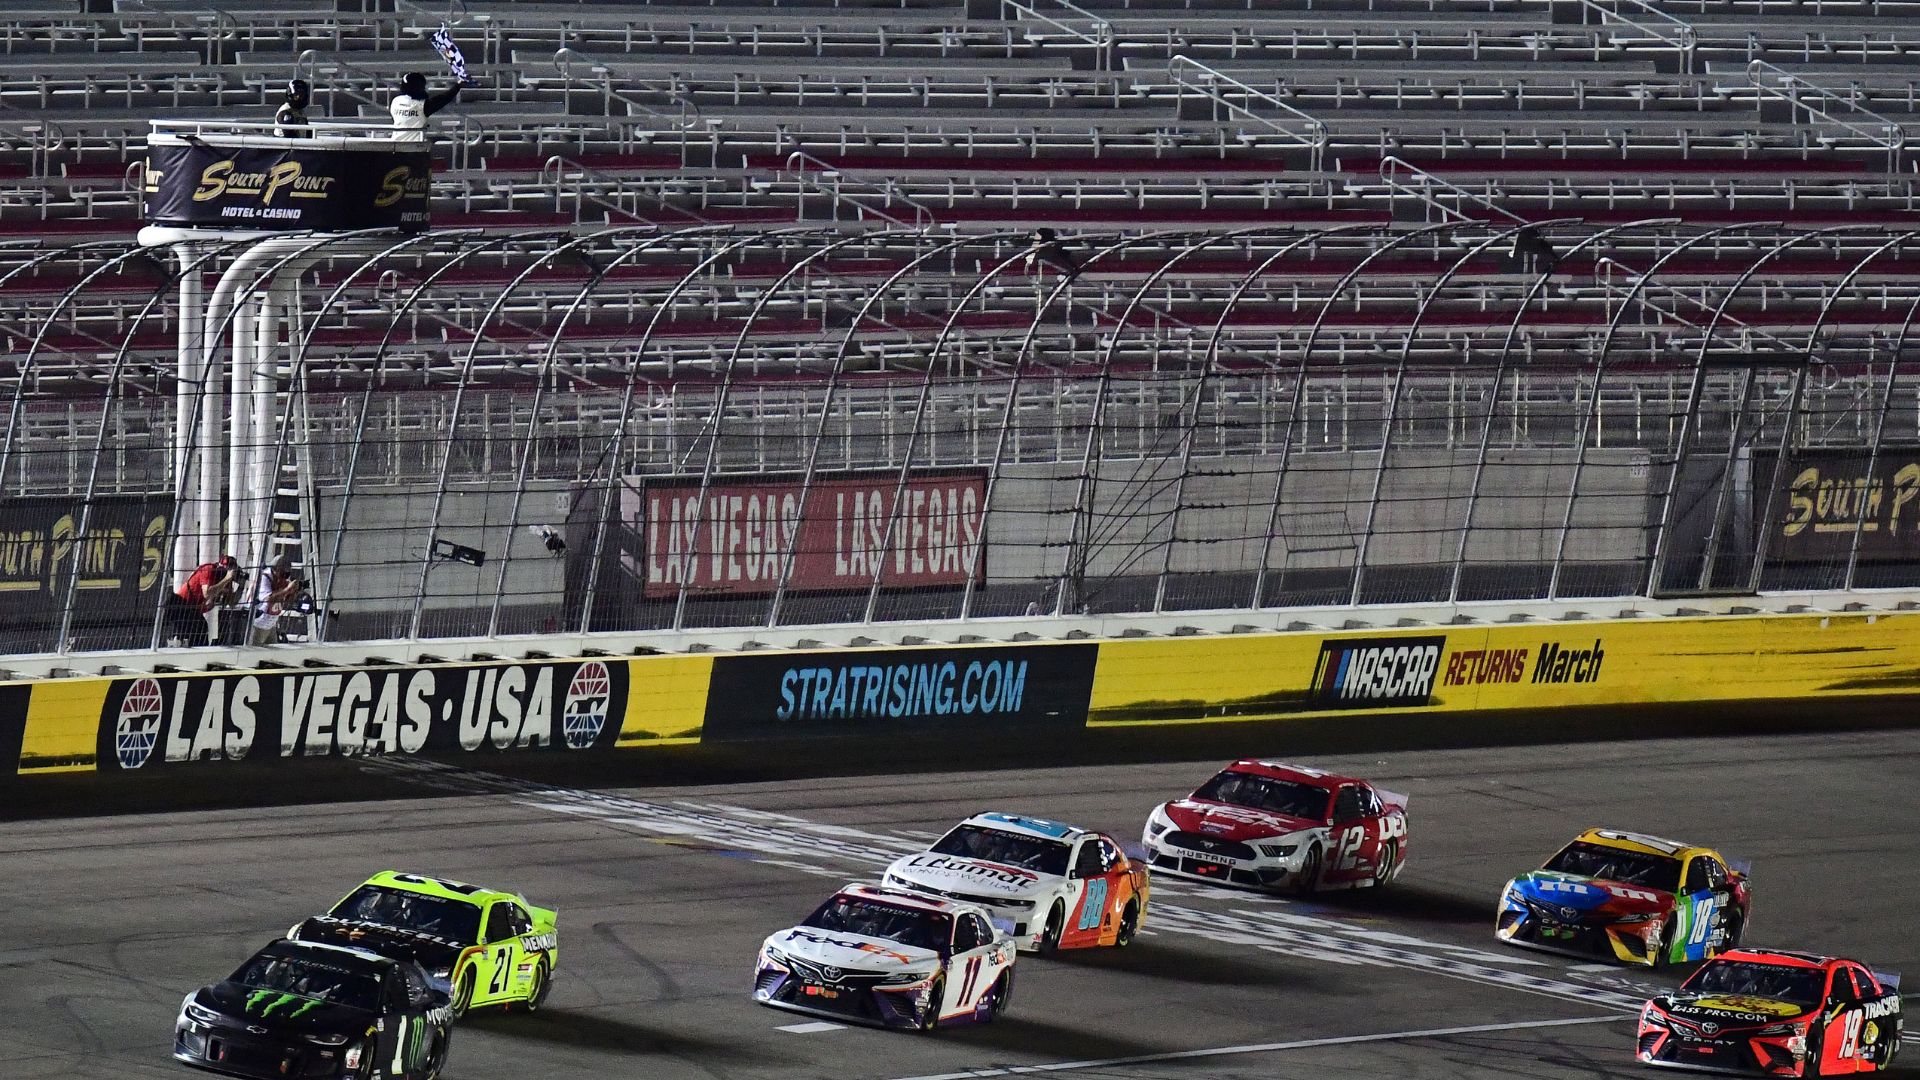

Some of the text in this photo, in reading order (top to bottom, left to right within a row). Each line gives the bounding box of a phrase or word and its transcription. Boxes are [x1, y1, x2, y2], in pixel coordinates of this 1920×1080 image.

[192, 160, 336, 206] SOUTH POINT
[221, 206, 255, 218] HOTEL
[262, 208, 302, 219] CASINO
[1783, 467, 1883, 537] SOUTH
[649, 492, 796, 584] LAS VEGAS
[835, 486, 978, 577] LAS VEGAS
[776, 659, 1029, 722] STRATRISING.COM
[1340, 638, 1605, 700] NASCAR RETURNS March
[164, 665, 554, 763] LAS VEGAS USA
[1177, 848, 1237, 866] MUSTANG
[1333, 825, 1365, 870] 12
[1077, 876, 1107, 931] 88
[1688, 898, 1714, 946] 18
[312, 915, 467, 950] DURACELL
[785, 930, 911, 965] FedEx
[488, 946, 513, 995] 21
[955, 955, 983, 1008] 11
[1863, 995, 1900, 1020] TRACKER
[391, 1014, 407, 1075] 1
[1838, 1009, 1863, 1059] 19
